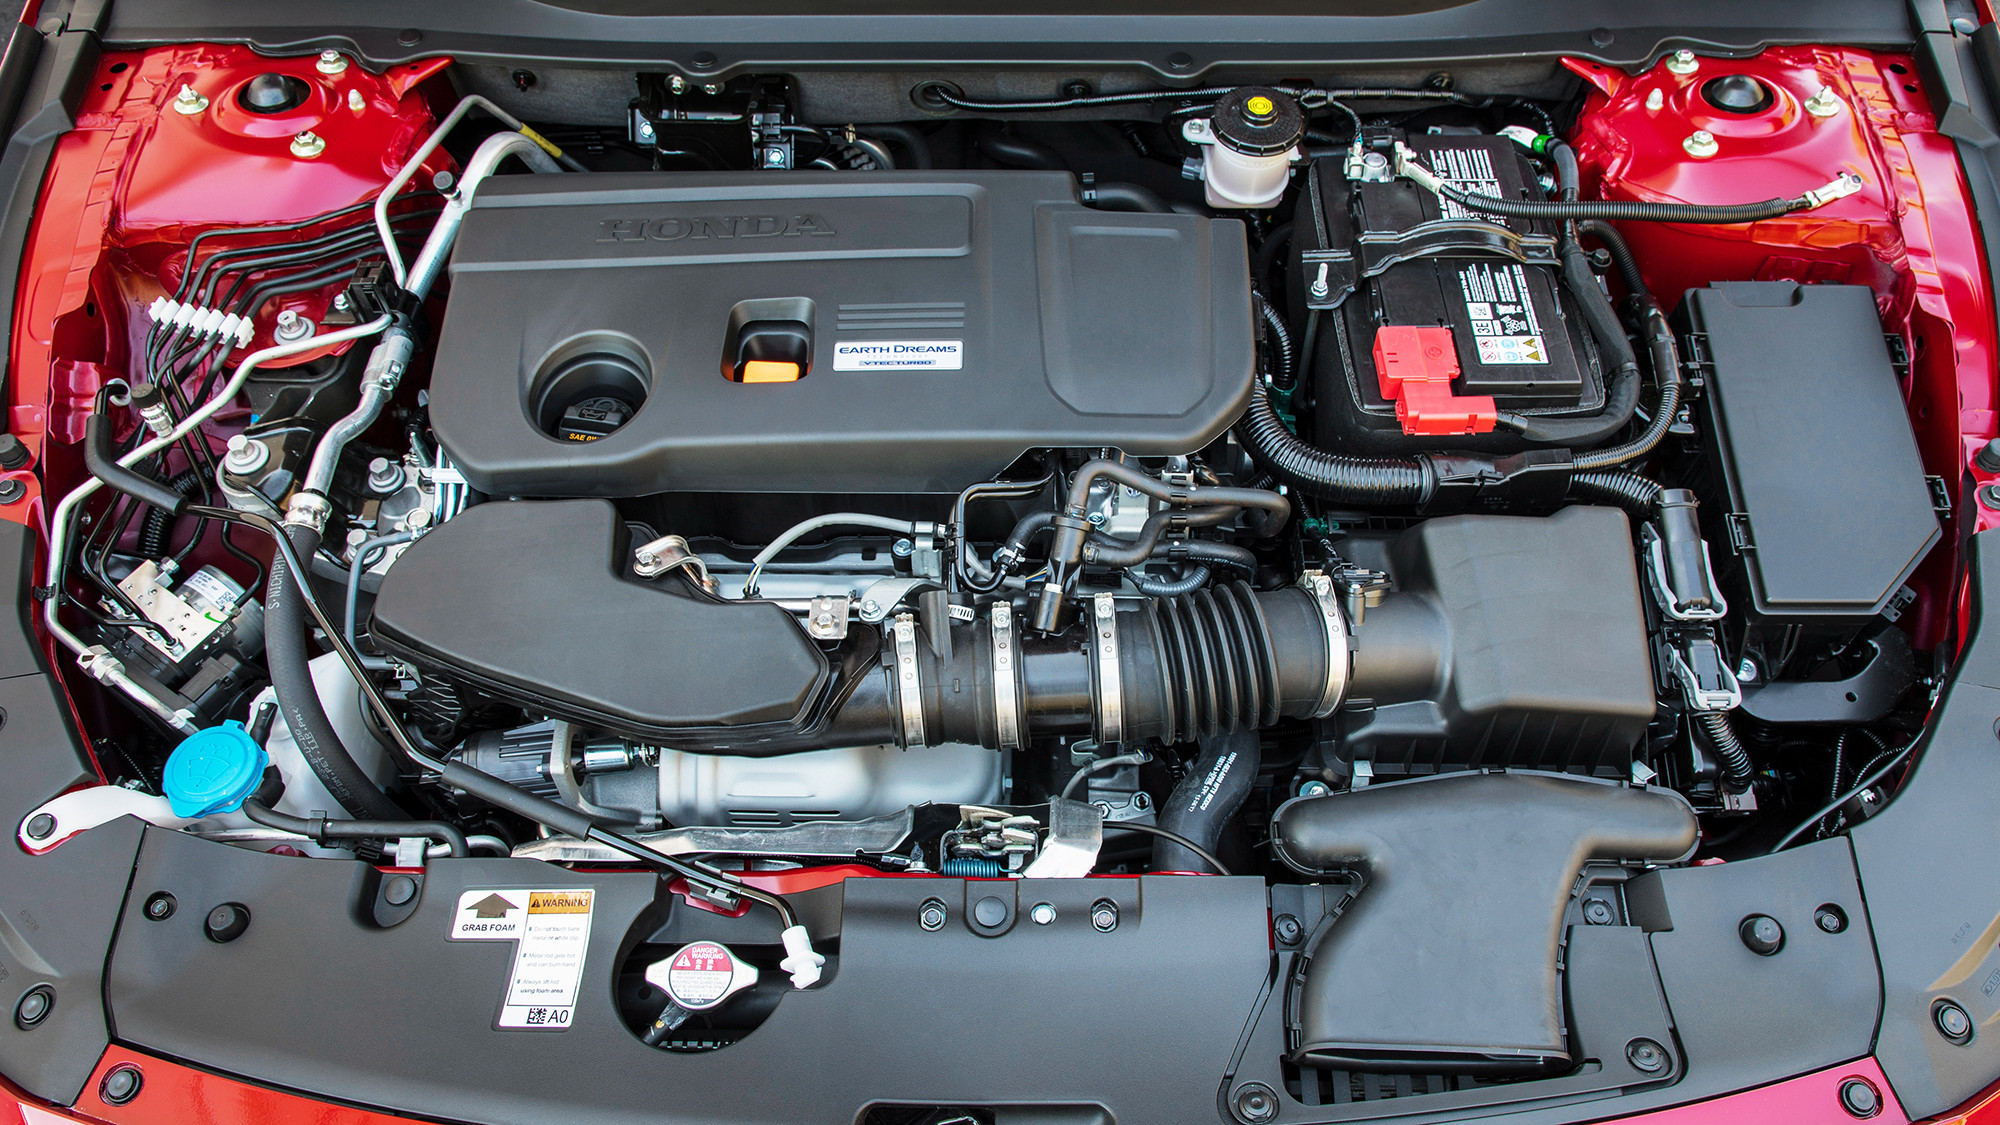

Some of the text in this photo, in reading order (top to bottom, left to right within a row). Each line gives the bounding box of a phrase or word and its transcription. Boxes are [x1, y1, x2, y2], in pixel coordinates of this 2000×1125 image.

[596, 214, 836, 242] HONDA
[1476, 322, 1490, 333] 3E
[839, 345, 957, 354] EARTH DREAMS
[569, 433, 585, 441] SAE
[542, 898, 588, 907] WARNING
[461, 924, 516, 932] GRAB FOAM
[547, 1010, 569, 1024] A0
